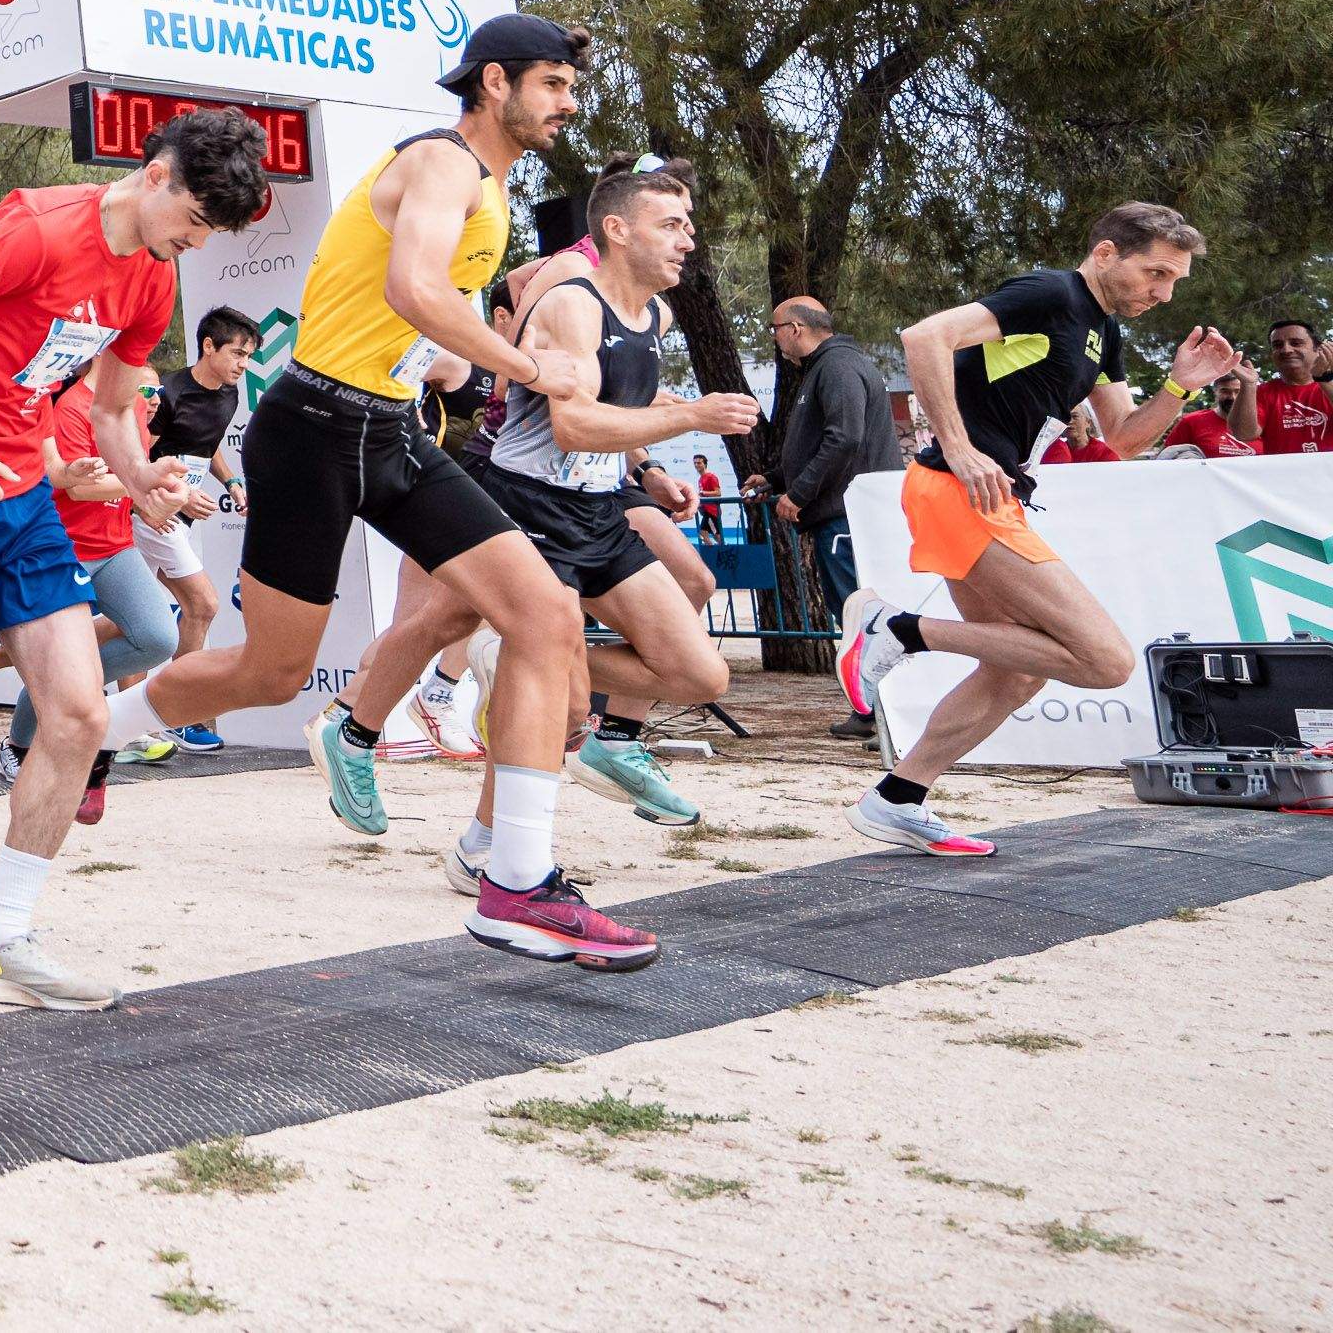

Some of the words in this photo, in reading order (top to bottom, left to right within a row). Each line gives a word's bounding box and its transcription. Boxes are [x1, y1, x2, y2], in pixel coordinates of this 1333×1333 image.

[144, 9, 375, 74] REUMÁTICAS
[219, 255, 295, 281] sorcom
[334, 386, 369, 407] NIKE
[186, 474, 202, 485] 789
